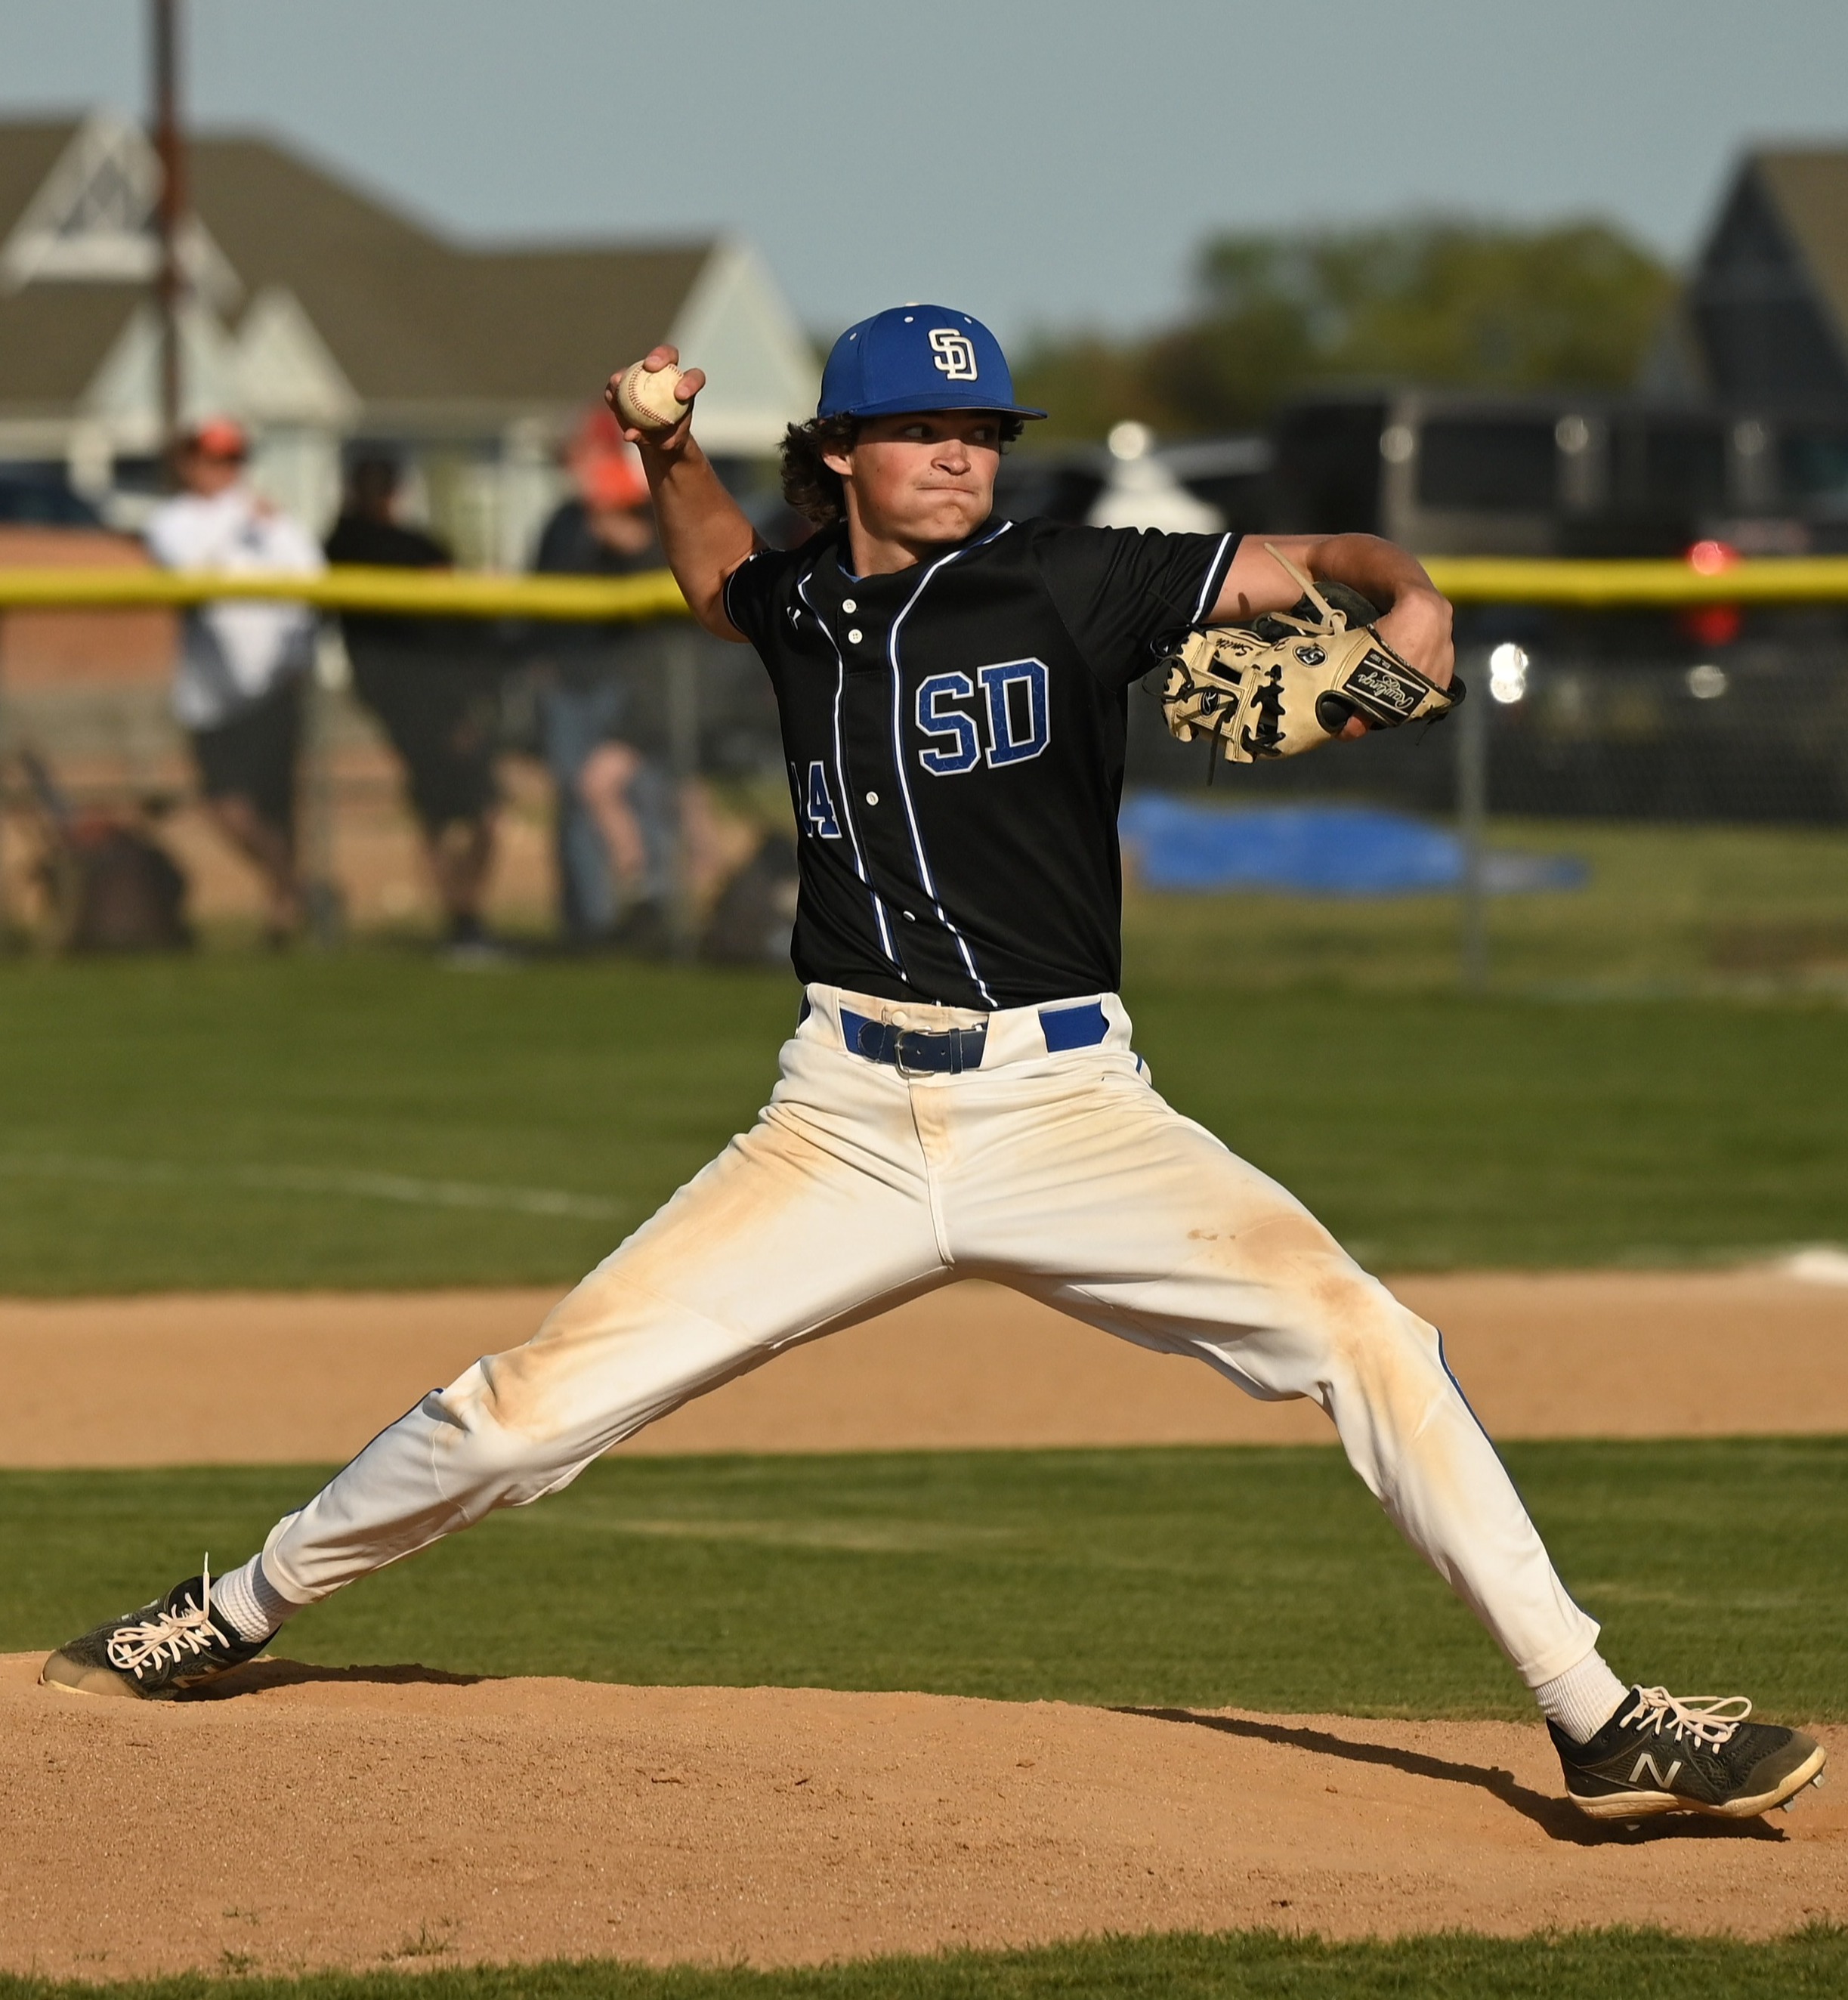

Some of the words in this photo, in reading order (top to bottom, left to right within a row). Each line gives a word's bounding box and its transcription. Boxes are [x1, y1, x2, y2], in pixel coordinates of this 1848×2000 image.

[928, 328, 978, 381] SD
[1216, 638, 1253, 657] Smith
[1358, 671, 1414, 709] Rawlings
[915, 657, 1051, 777] SD
[1628, 1752, 1682, 1789] N
